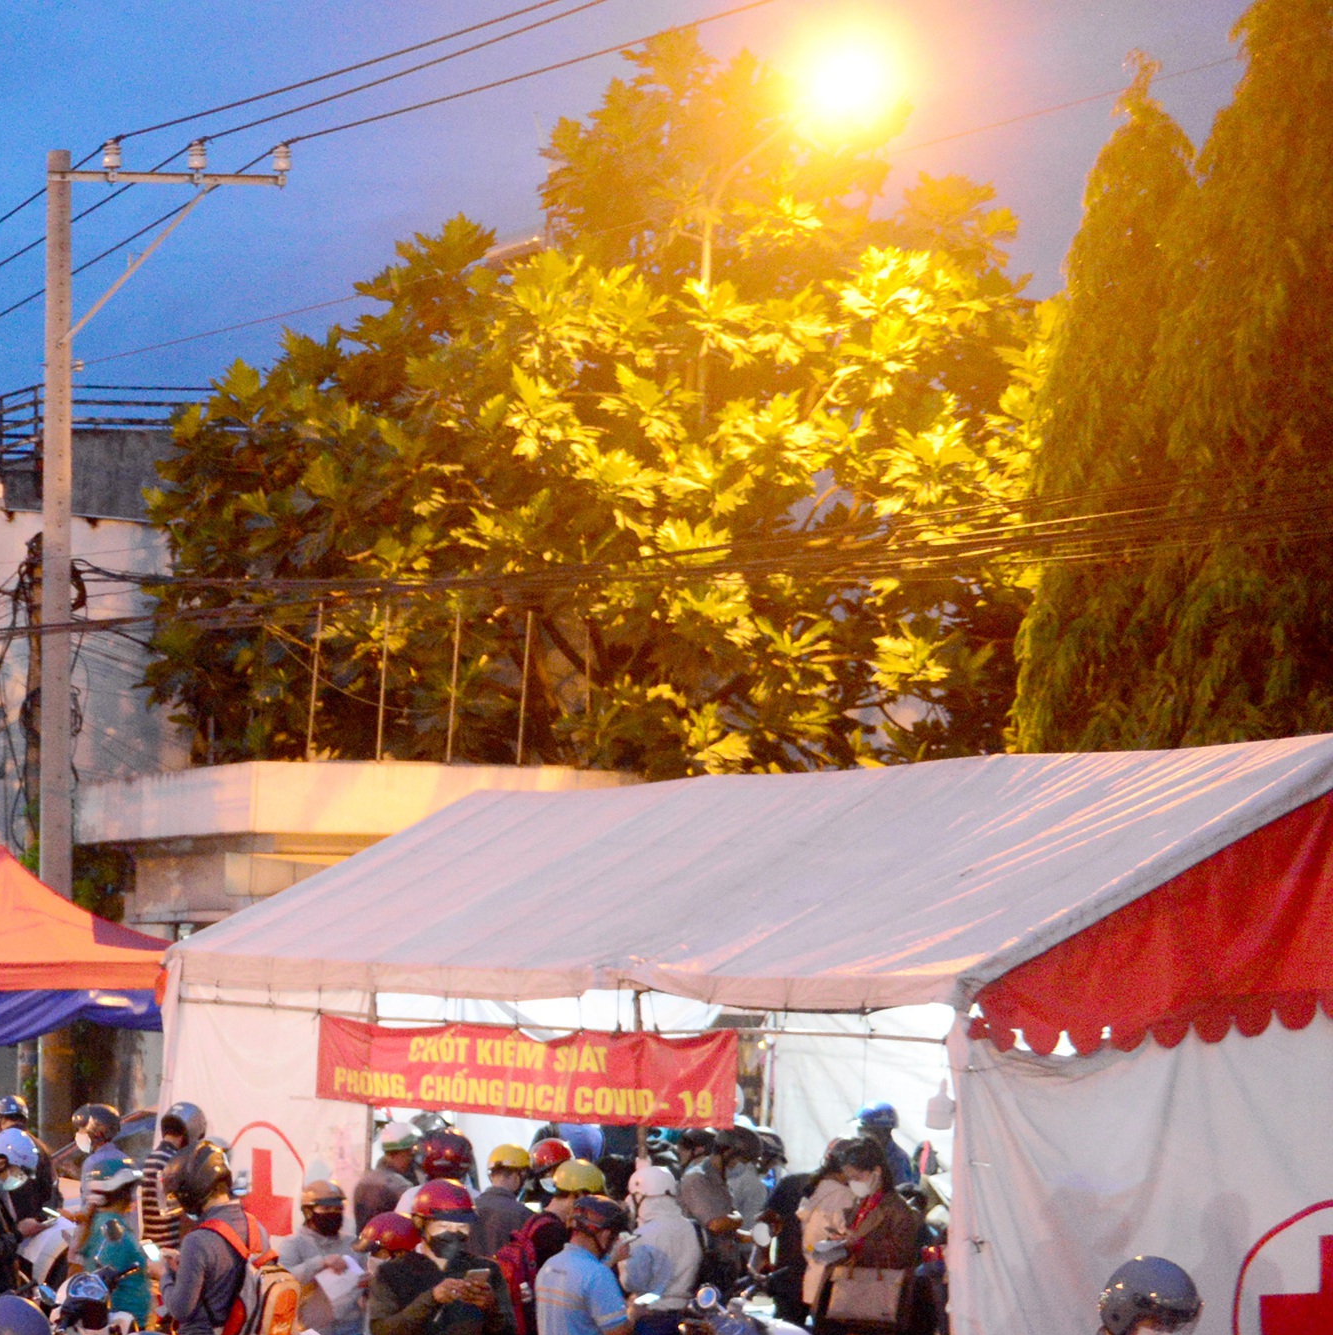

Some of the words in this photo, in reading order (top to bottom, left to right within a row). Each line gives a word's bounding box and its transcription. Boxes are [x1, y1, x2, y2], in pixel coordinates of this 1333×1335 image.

[408, 1028, 470, 1063] CHỐT
[476, 1030, 546, 1071] KIỂM
[419, 1068, 504, 1106] CHỐNG
[506, 1081, 568, 1115] DỊCH
[574, 1086, 656, 1117] COVID
[678, 1090, 714, 1118] 19
